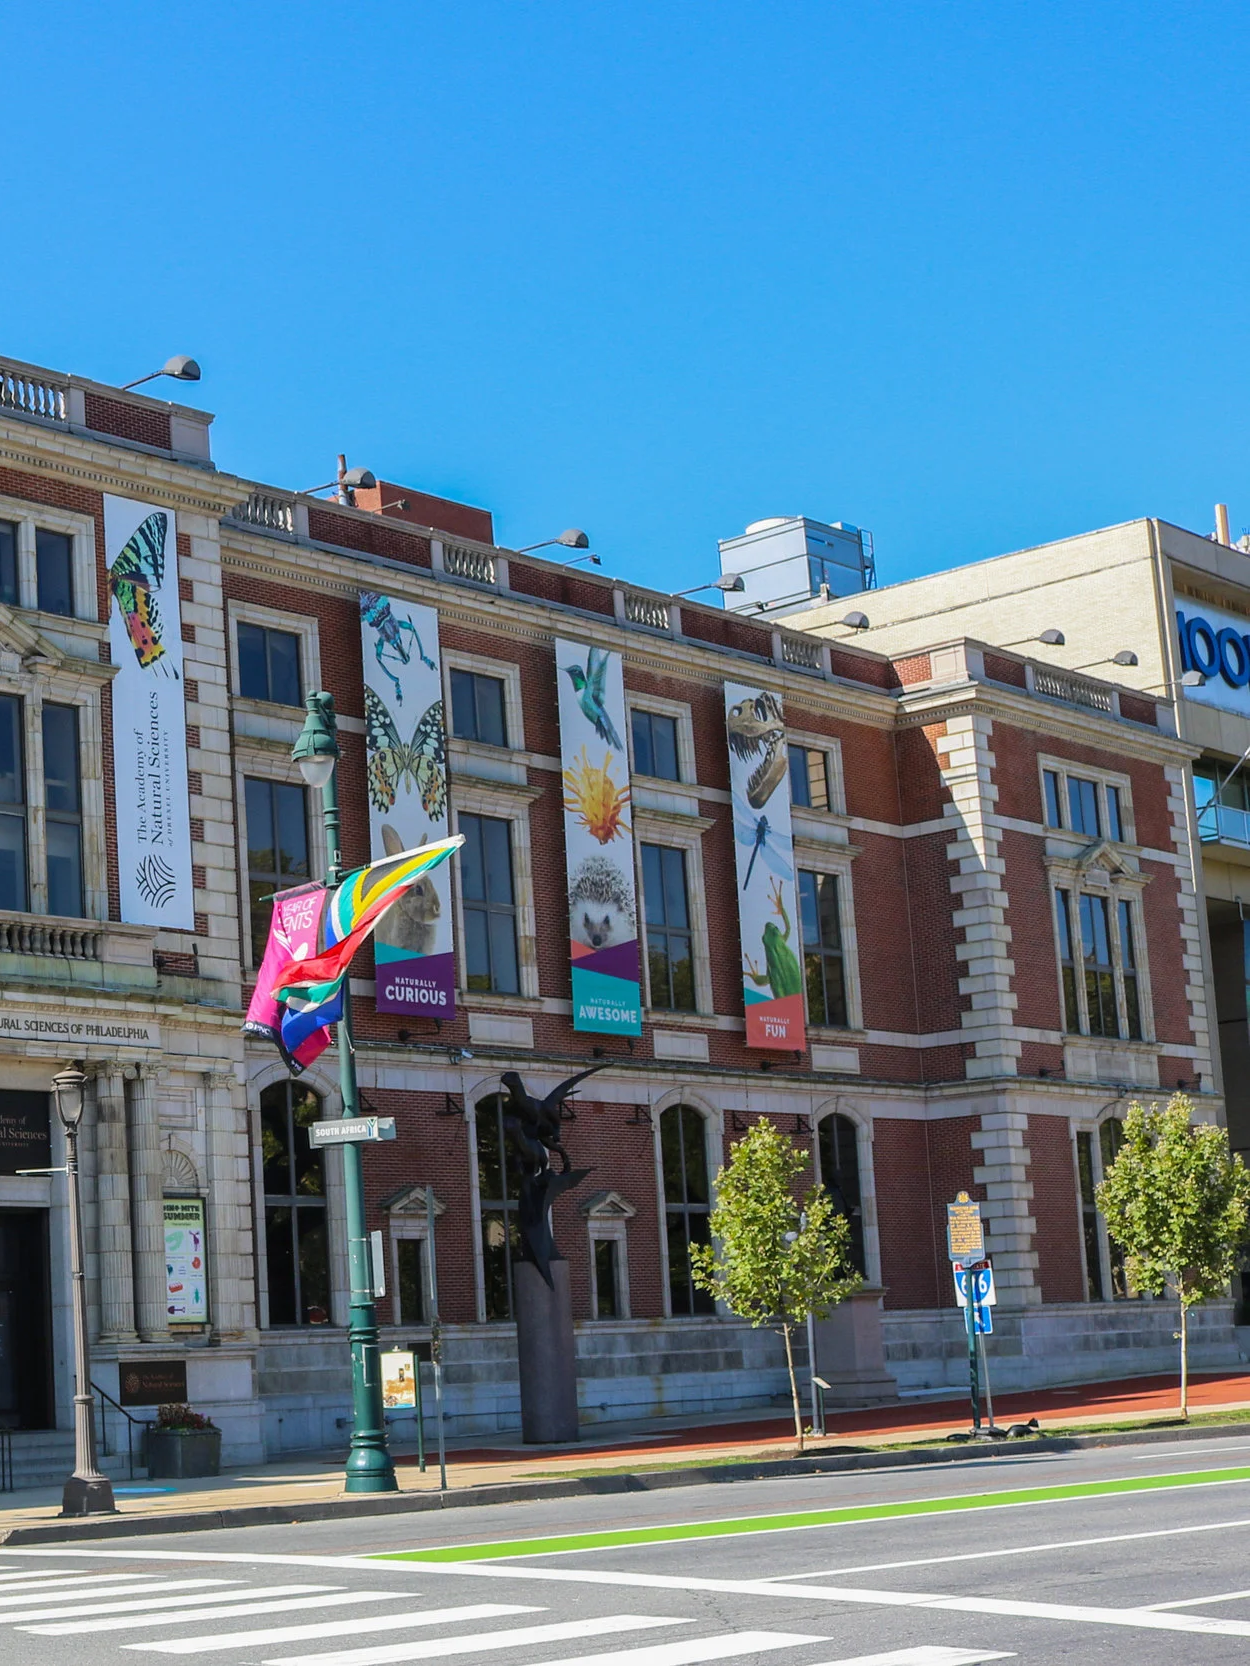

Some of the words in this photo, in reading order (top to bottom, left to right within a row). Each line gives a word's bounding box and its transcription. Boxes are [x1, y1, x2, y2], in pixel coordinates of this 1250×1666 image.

[134, 729, 143, 745] of
[147, 691, 161, 769] Sciences
[135, 748, 147, 814] Academy
[148, 773, 163, 845] Natural
[137, 816, 147, 844] The
[302, 896, 318, 911] OF
[395, 976, 437, 988] NATURALLY
[385, 985, 447, 1006] CURIOUS
[590, 997, 626, 1007] NATURALLY
[579, 1004, 637, 1024] AWESOME
[759, 1016, 790, 1025] NATURALLY
[24, 1020, 69, 1034] SCIENCES
[70, 1023, 83, 1035] OF
[86, 1025, 150, 1040] PHILADELPHIA
[254, 1025, 270, 1035] PNC
[765, 1024, 786, 1039] FUN
[18, 1116, 27, 1125] of
[8, 1127, 48, 1140] Sciences
[315, 1127, 340, 1137] SOUTH
[341, 1125, 367, 1135] AFRICA
[163, 1212, 200, 1221] SUMMER
